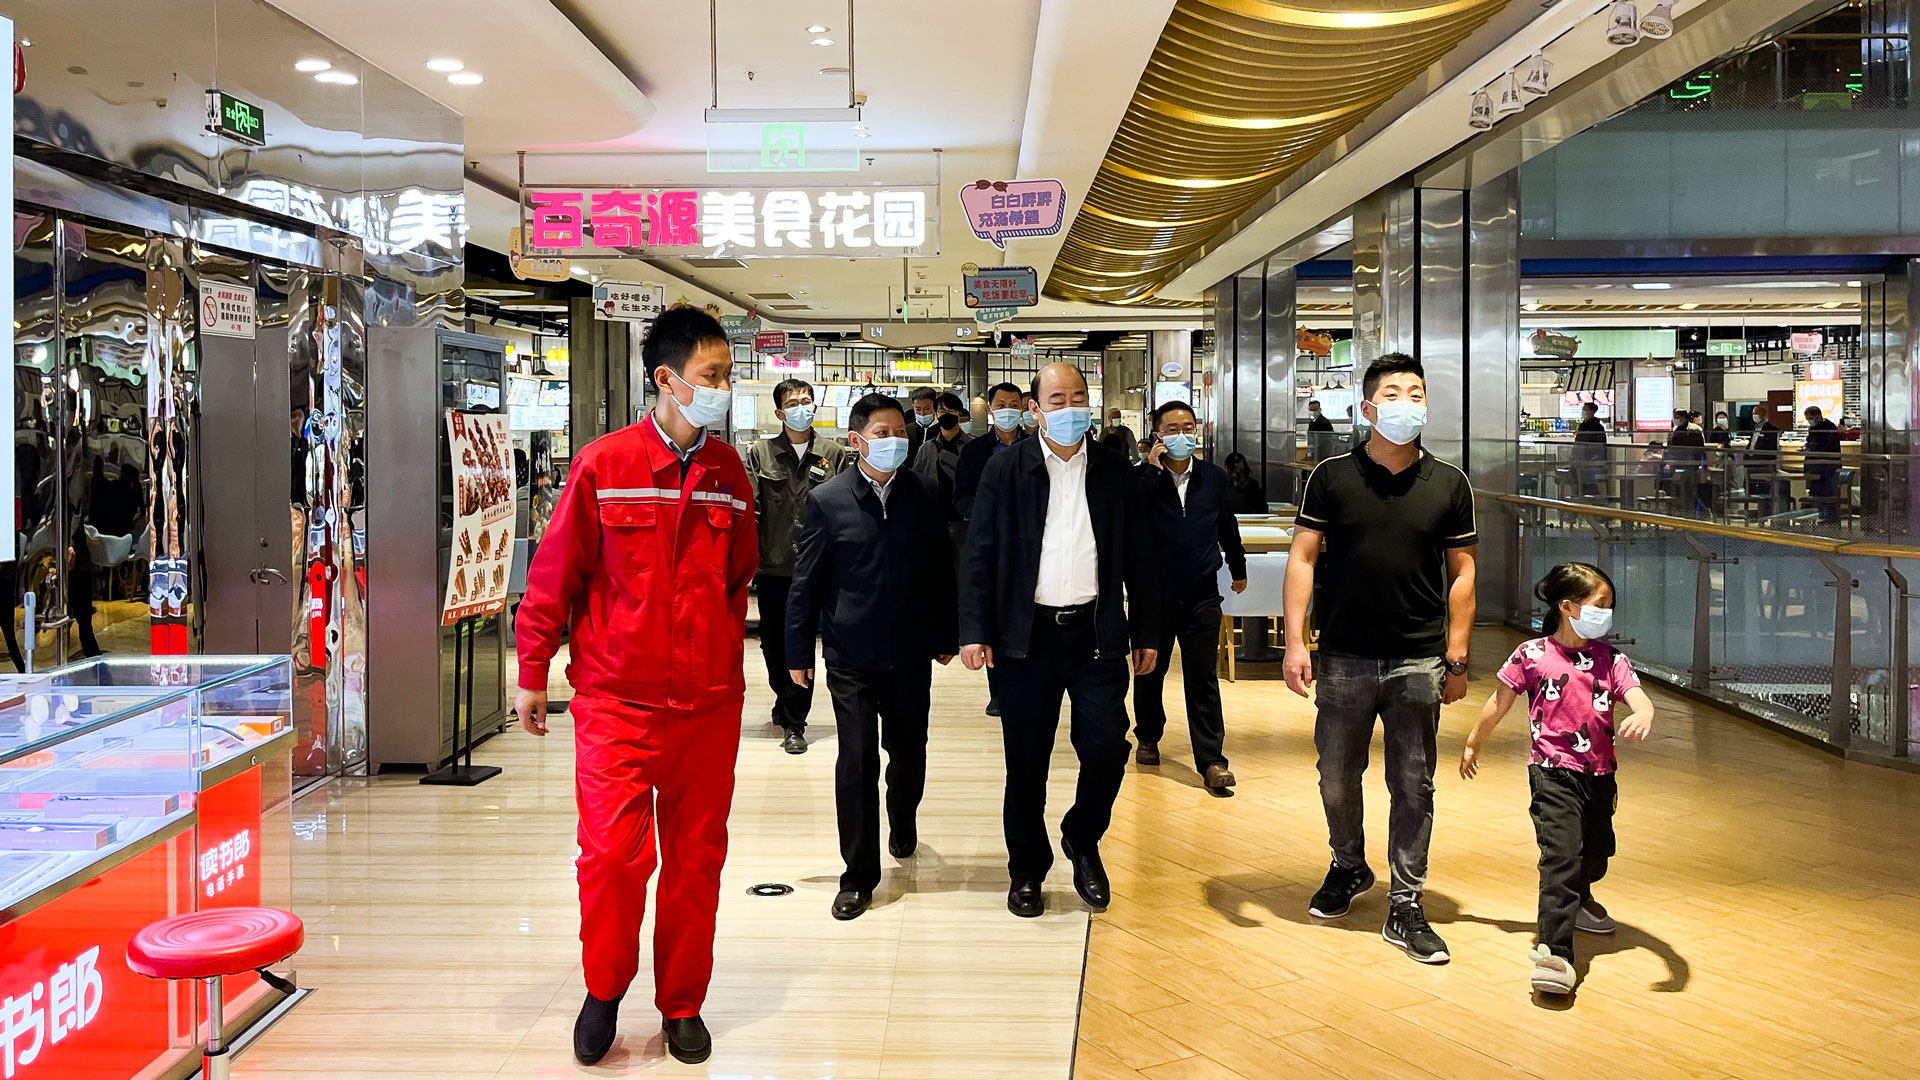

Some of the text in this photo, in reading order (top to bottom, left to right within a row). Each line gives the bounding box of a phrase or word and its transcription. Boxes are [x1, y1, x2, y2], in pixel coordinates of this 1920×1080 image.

[991, 191, 1052, 210] 白白胖胖
[531, 190, 926, 248] 百奇源美食花园
[978, 209, 1040, 228] 充满希望
[973, 279, 1017, 290] 美食无限好
[610, 292, 651, 303] 吃好喝好
[621, 303, 662, 314] 长生不老
[200, 829, 250, 881] 读书郎
[206, 864, 245, 897] 电话手表
[0, 945, 103, 1079] 书郎
